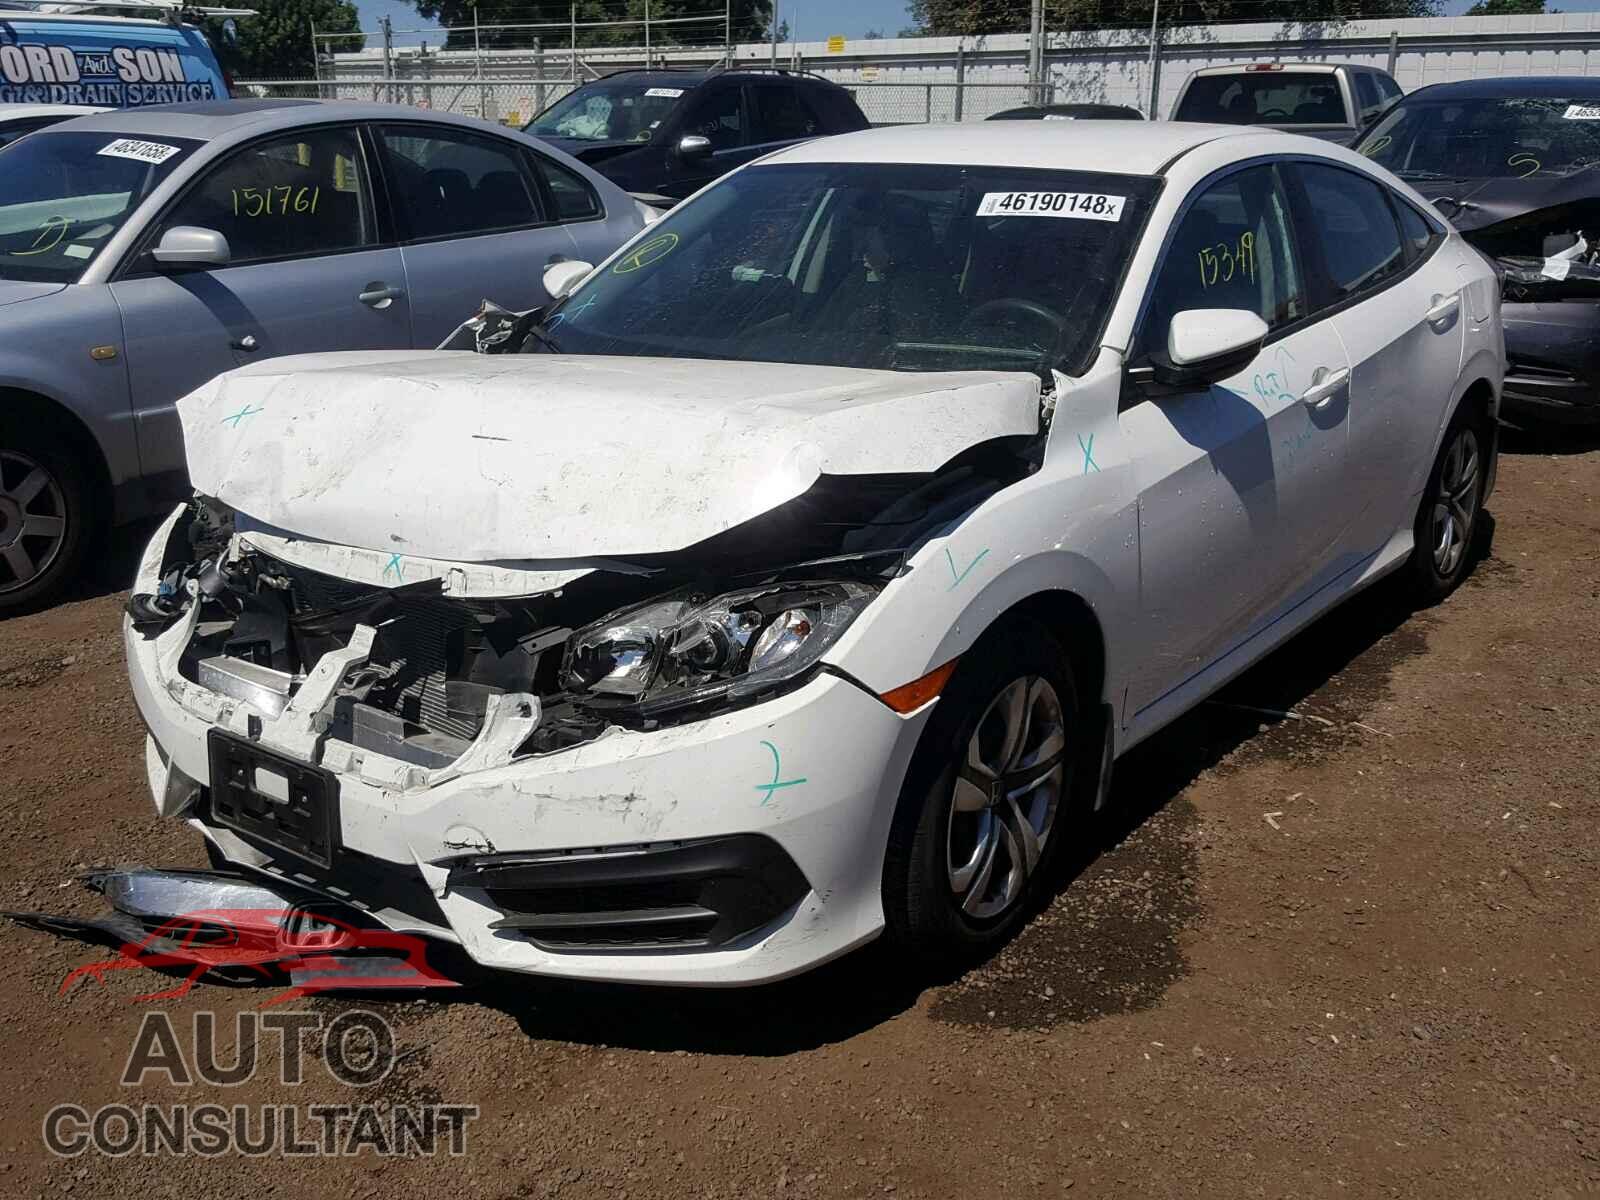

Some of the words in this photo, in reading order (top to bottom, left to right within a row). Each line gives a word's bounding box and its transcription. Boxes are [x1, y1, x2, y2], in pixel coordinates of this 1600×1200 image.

[0, 46, 79, 83] ORD
[84, 55, 113, 74] And
[113, 48, 185, 82] SON
[49, 84, 121, 104] DRAIN
[127, 83, 214, 104] SERVICE
[231, 185, 320, 217] 151761
